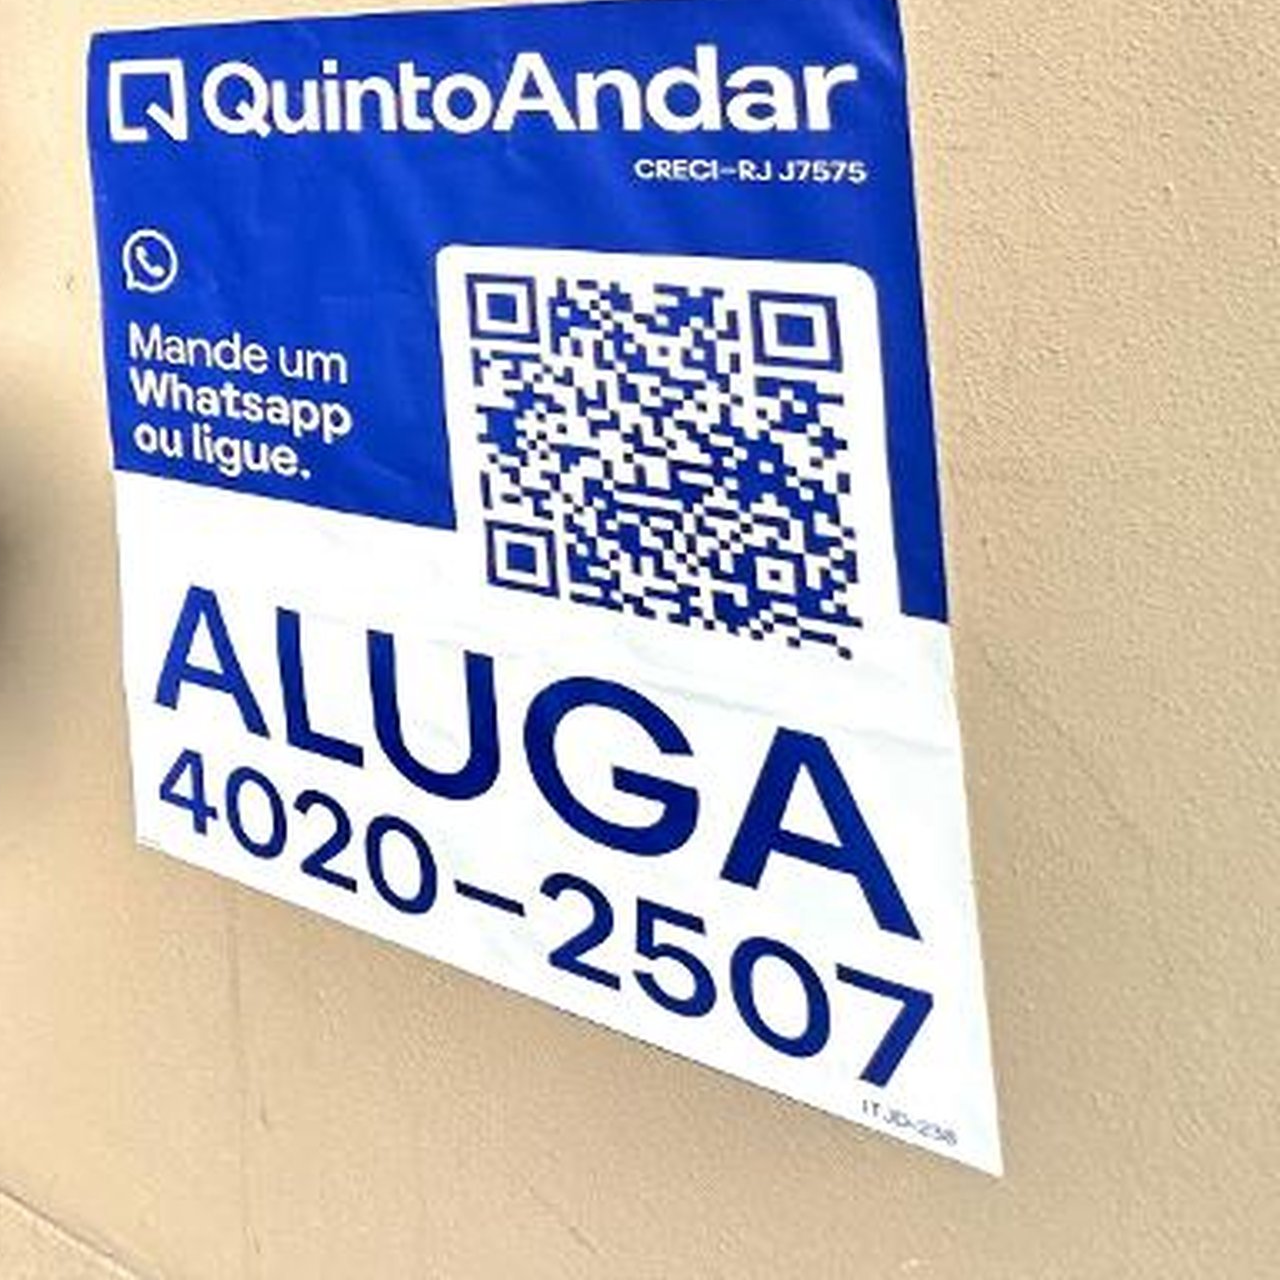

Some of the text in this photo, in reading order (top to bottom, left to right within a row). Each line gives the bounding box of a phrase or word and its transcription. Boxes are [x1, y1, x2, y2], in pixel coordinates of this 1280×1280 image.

[201, 44, 858, 138] QuintoAndar
[634, 158, 868, 185] CRECI-RJ J7575
[129, 321, 348, 384] Mande um
[129, 366, 353, 444] Whatsapp
[134, 422, 311, 480] ou ligue.
[155, 585, 922, 941] ALUGA
[159, 749, 932, 1088] 4020-2507
